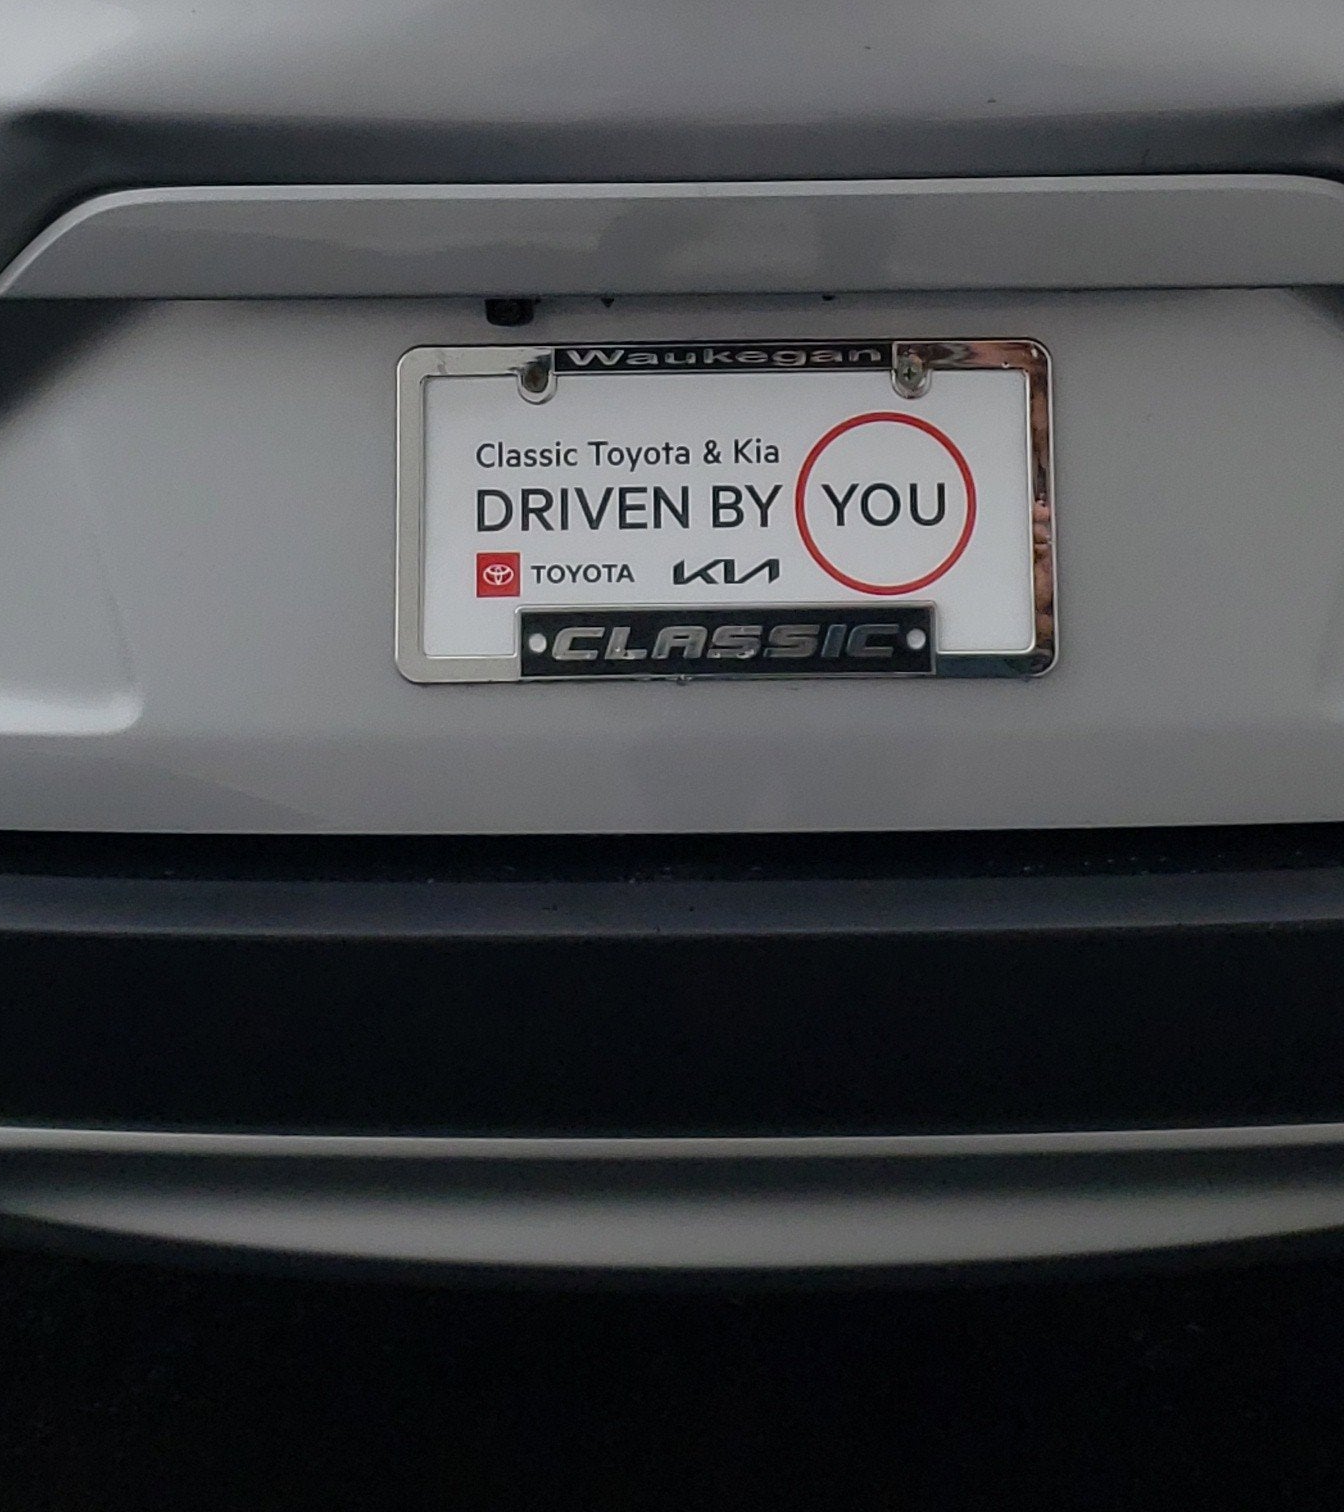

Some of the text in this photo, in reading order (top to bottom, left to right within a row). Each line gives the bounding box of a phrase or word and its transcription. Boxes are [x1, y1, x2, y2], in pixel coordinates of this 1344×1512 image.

[565, 347, 882, 367] Waukegan
[476, 437, 781, 472] Classic Toyota & Kia
[476, 482, 946, 532] DRIVEN BY YOU
[531, 563, 635, 584] TOYOTA
[550, 623, 901, 661] CLASSIC
